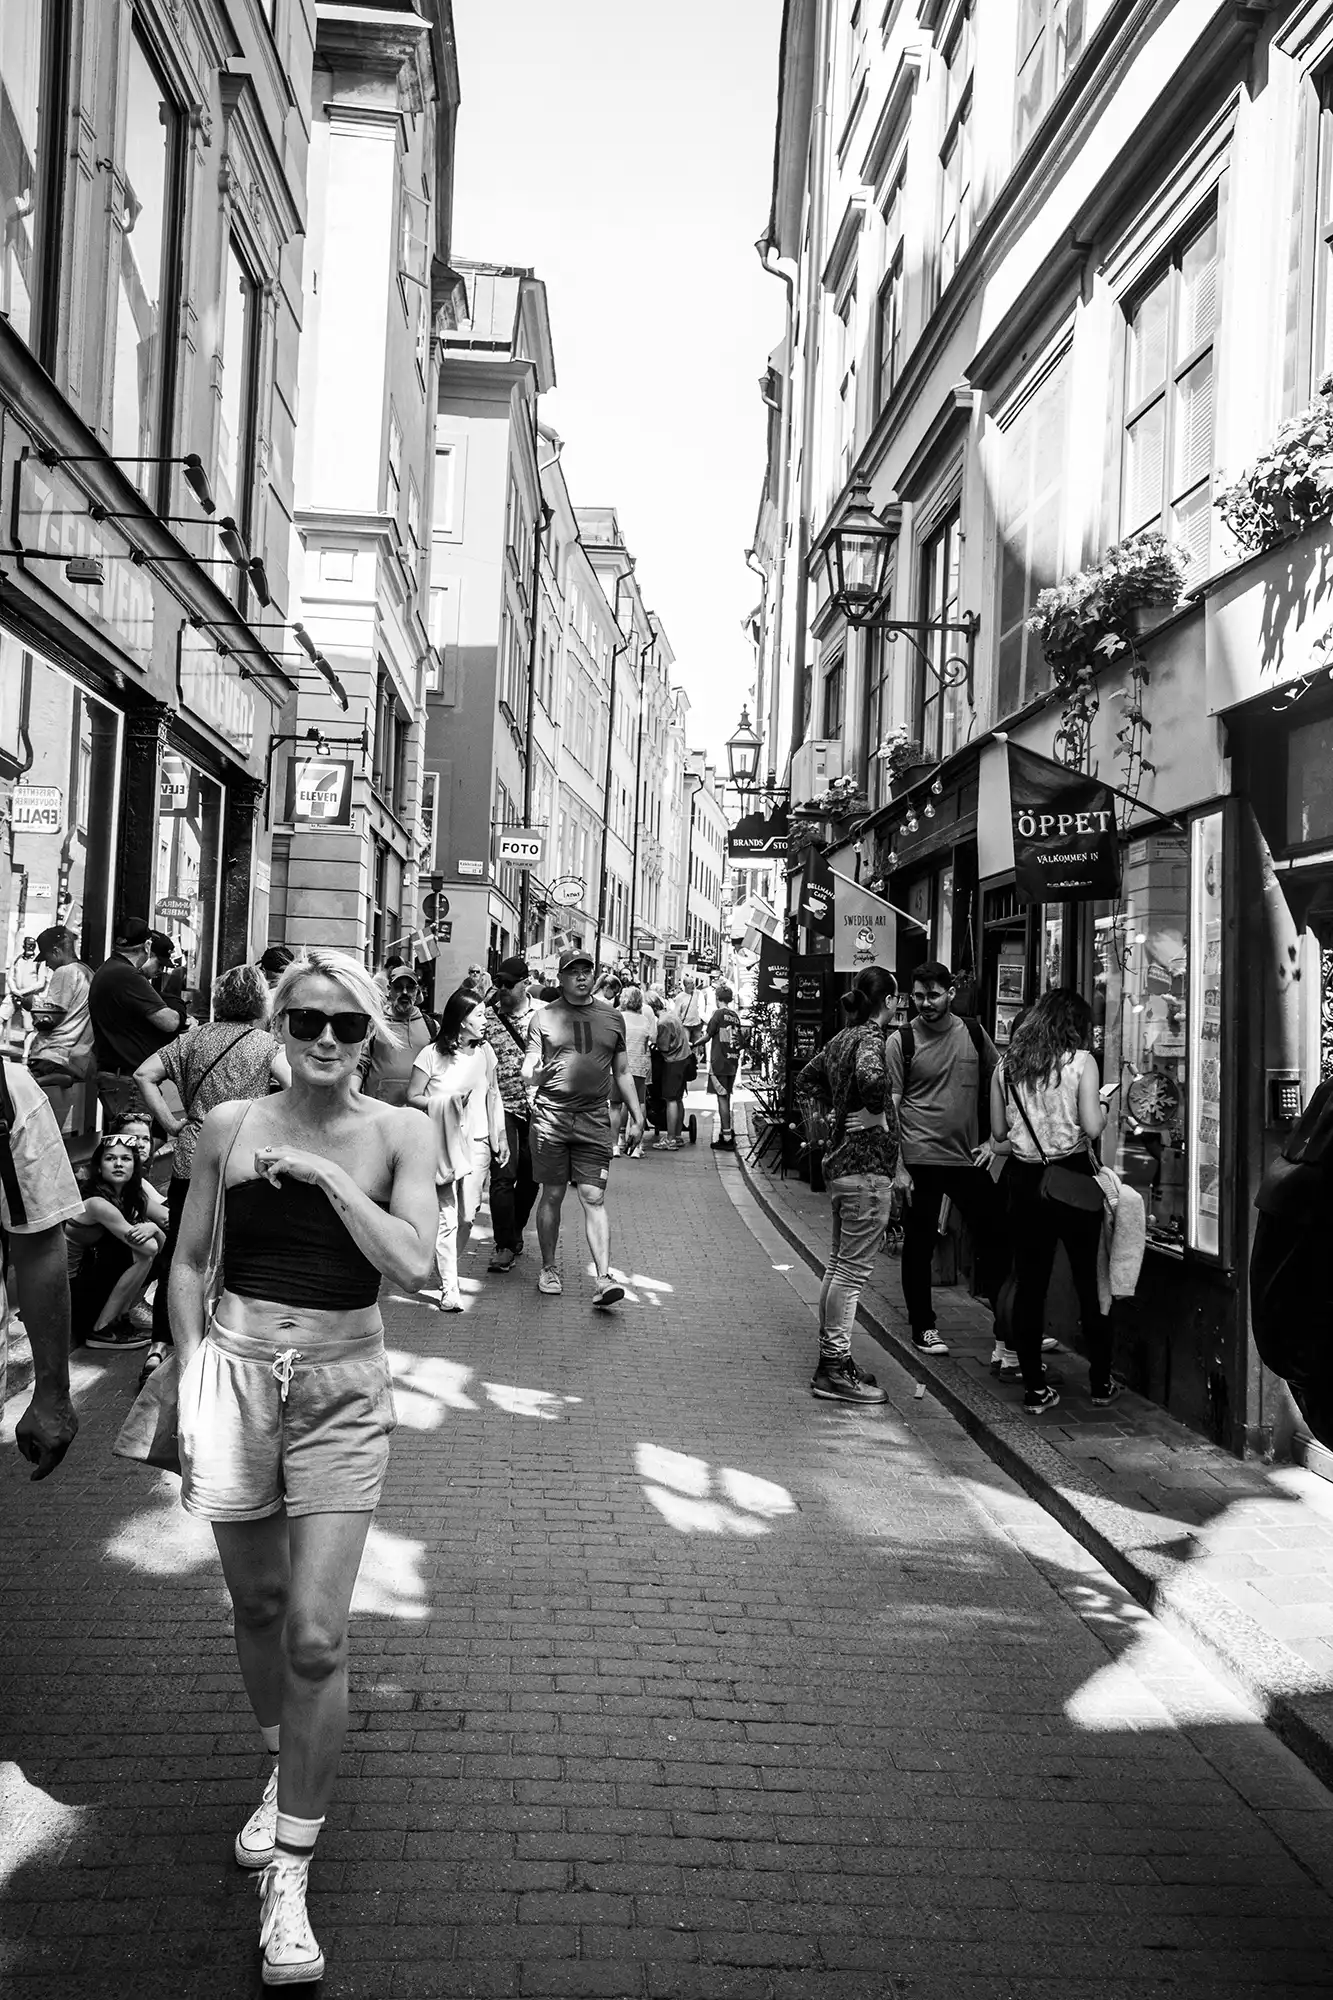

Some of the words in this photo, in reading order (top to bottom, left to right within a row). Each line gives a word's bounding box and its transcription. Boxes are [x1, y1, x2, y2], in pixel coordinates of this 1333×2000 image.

[1018, 809, 1111, 837] ÖPPET
[733, 838, 764, 847] BRANDS
[502, 842, 539, 855] FOTO
[1090, 851, 1099, 861] IN
[843, 915, 873, 926] SWEDISH
[874, 915, 887, 926] ART
